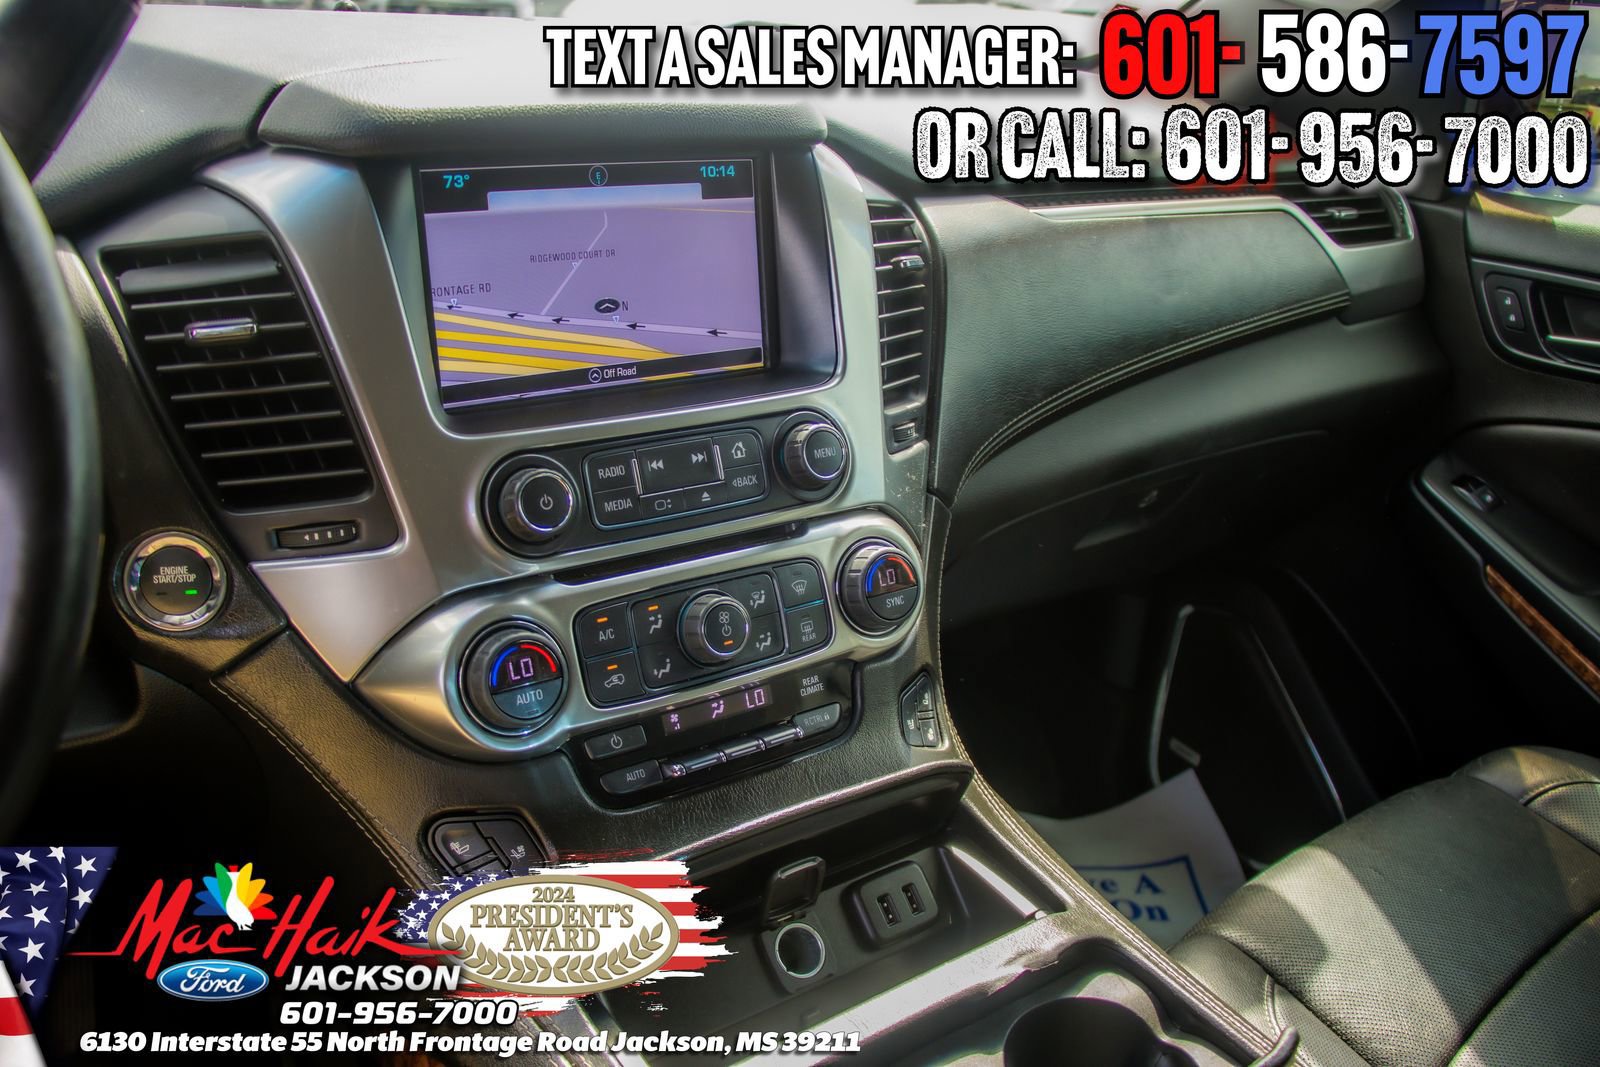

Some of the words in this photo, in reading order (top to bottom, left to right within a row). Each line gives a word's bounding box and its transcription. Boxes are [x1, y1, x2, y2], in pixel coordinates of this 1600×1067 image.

[699, 165, 735, 178] 10:14
[443, 174, 470, 189] 73°
[529, 252, 576, 263] RIDGEWOOD
[578, 249, 602, 260] COURT
[605, 249, 616, 258] DR
[478, 282, 492, 293] RD
[622, 301, 629, 311] N
[603, 368, 616, 379] Off
[617, 366, 637, 377] Road
[814, 447, 836, 459] MENU
[598, 465, 626, 479] RADIO
[737, 475, 758, 487] BACK
[604, 500, 633, 513] MEDIA
[160, 566, 189, 575] ENGINE
[153, 574, 197, 584] START/STOP
[886, 596, 905, 608] SYNC
[599, 628, 615, 642] A/C
[802, 633, 817, 642] REAR
[802, 675, 819, 686] REAR
[800, 683, 825, 697] CLIMATE
[516, 688, 544, 706] AUTO
[626, 769, 646, 782] AUTO
[1135, 872, 1165, 895] A
